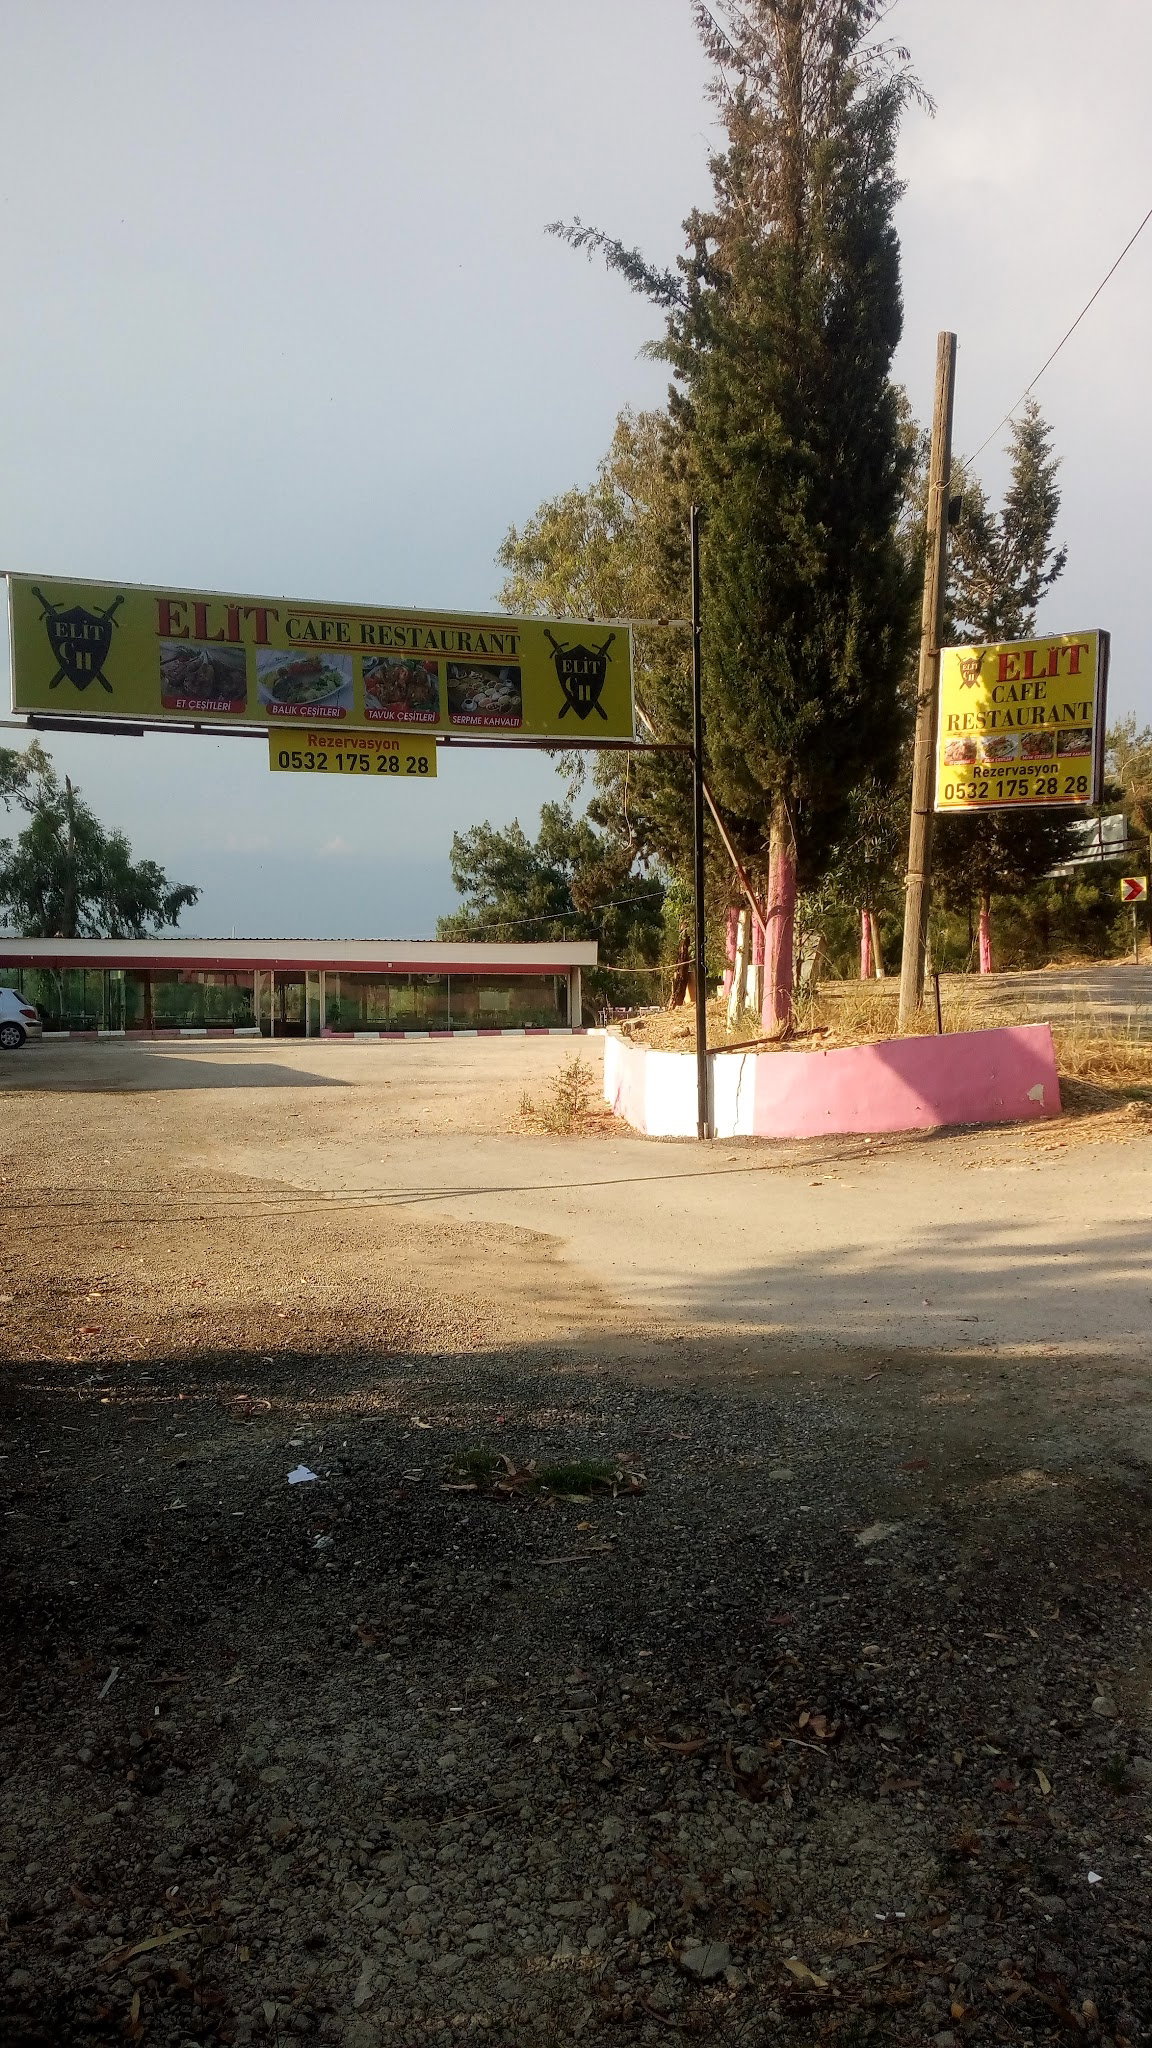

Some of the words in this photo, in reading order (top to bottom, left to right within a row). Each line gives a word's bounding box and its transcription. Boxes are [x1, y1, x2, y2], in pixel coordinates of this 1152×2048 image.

[286, 618, 351, 643] CAFE
[360, 623, 520, 654] RESTAURANT
[991, 681, 1047, 703] CAFE
[176, 699, 187, 708] ET
[272, 705, 296, 714] BALIK
[368, 710, 394, 720] TAVUK
[452, 715, 482, 725] SERPME
[483, 716, 520, 726] KAHVALTI
[947, 702, 1093, 731] RESTAURANT
[308, 734, 400, 752] Rezervasyon
[279, 751, 328, 770] 0532
[336, 753, 370, 771] 175
[376, 755, 400, 773] 28
[406, 757, 429, 774] 28
[973, 764, 1059, 779] Rezervasyon
[945, 782, 989, 800] 0532
[996, 779, 1028, 797] 175
[1035, 777, 1058, 796] 28
[1064, 776, 1088, 794] 28
